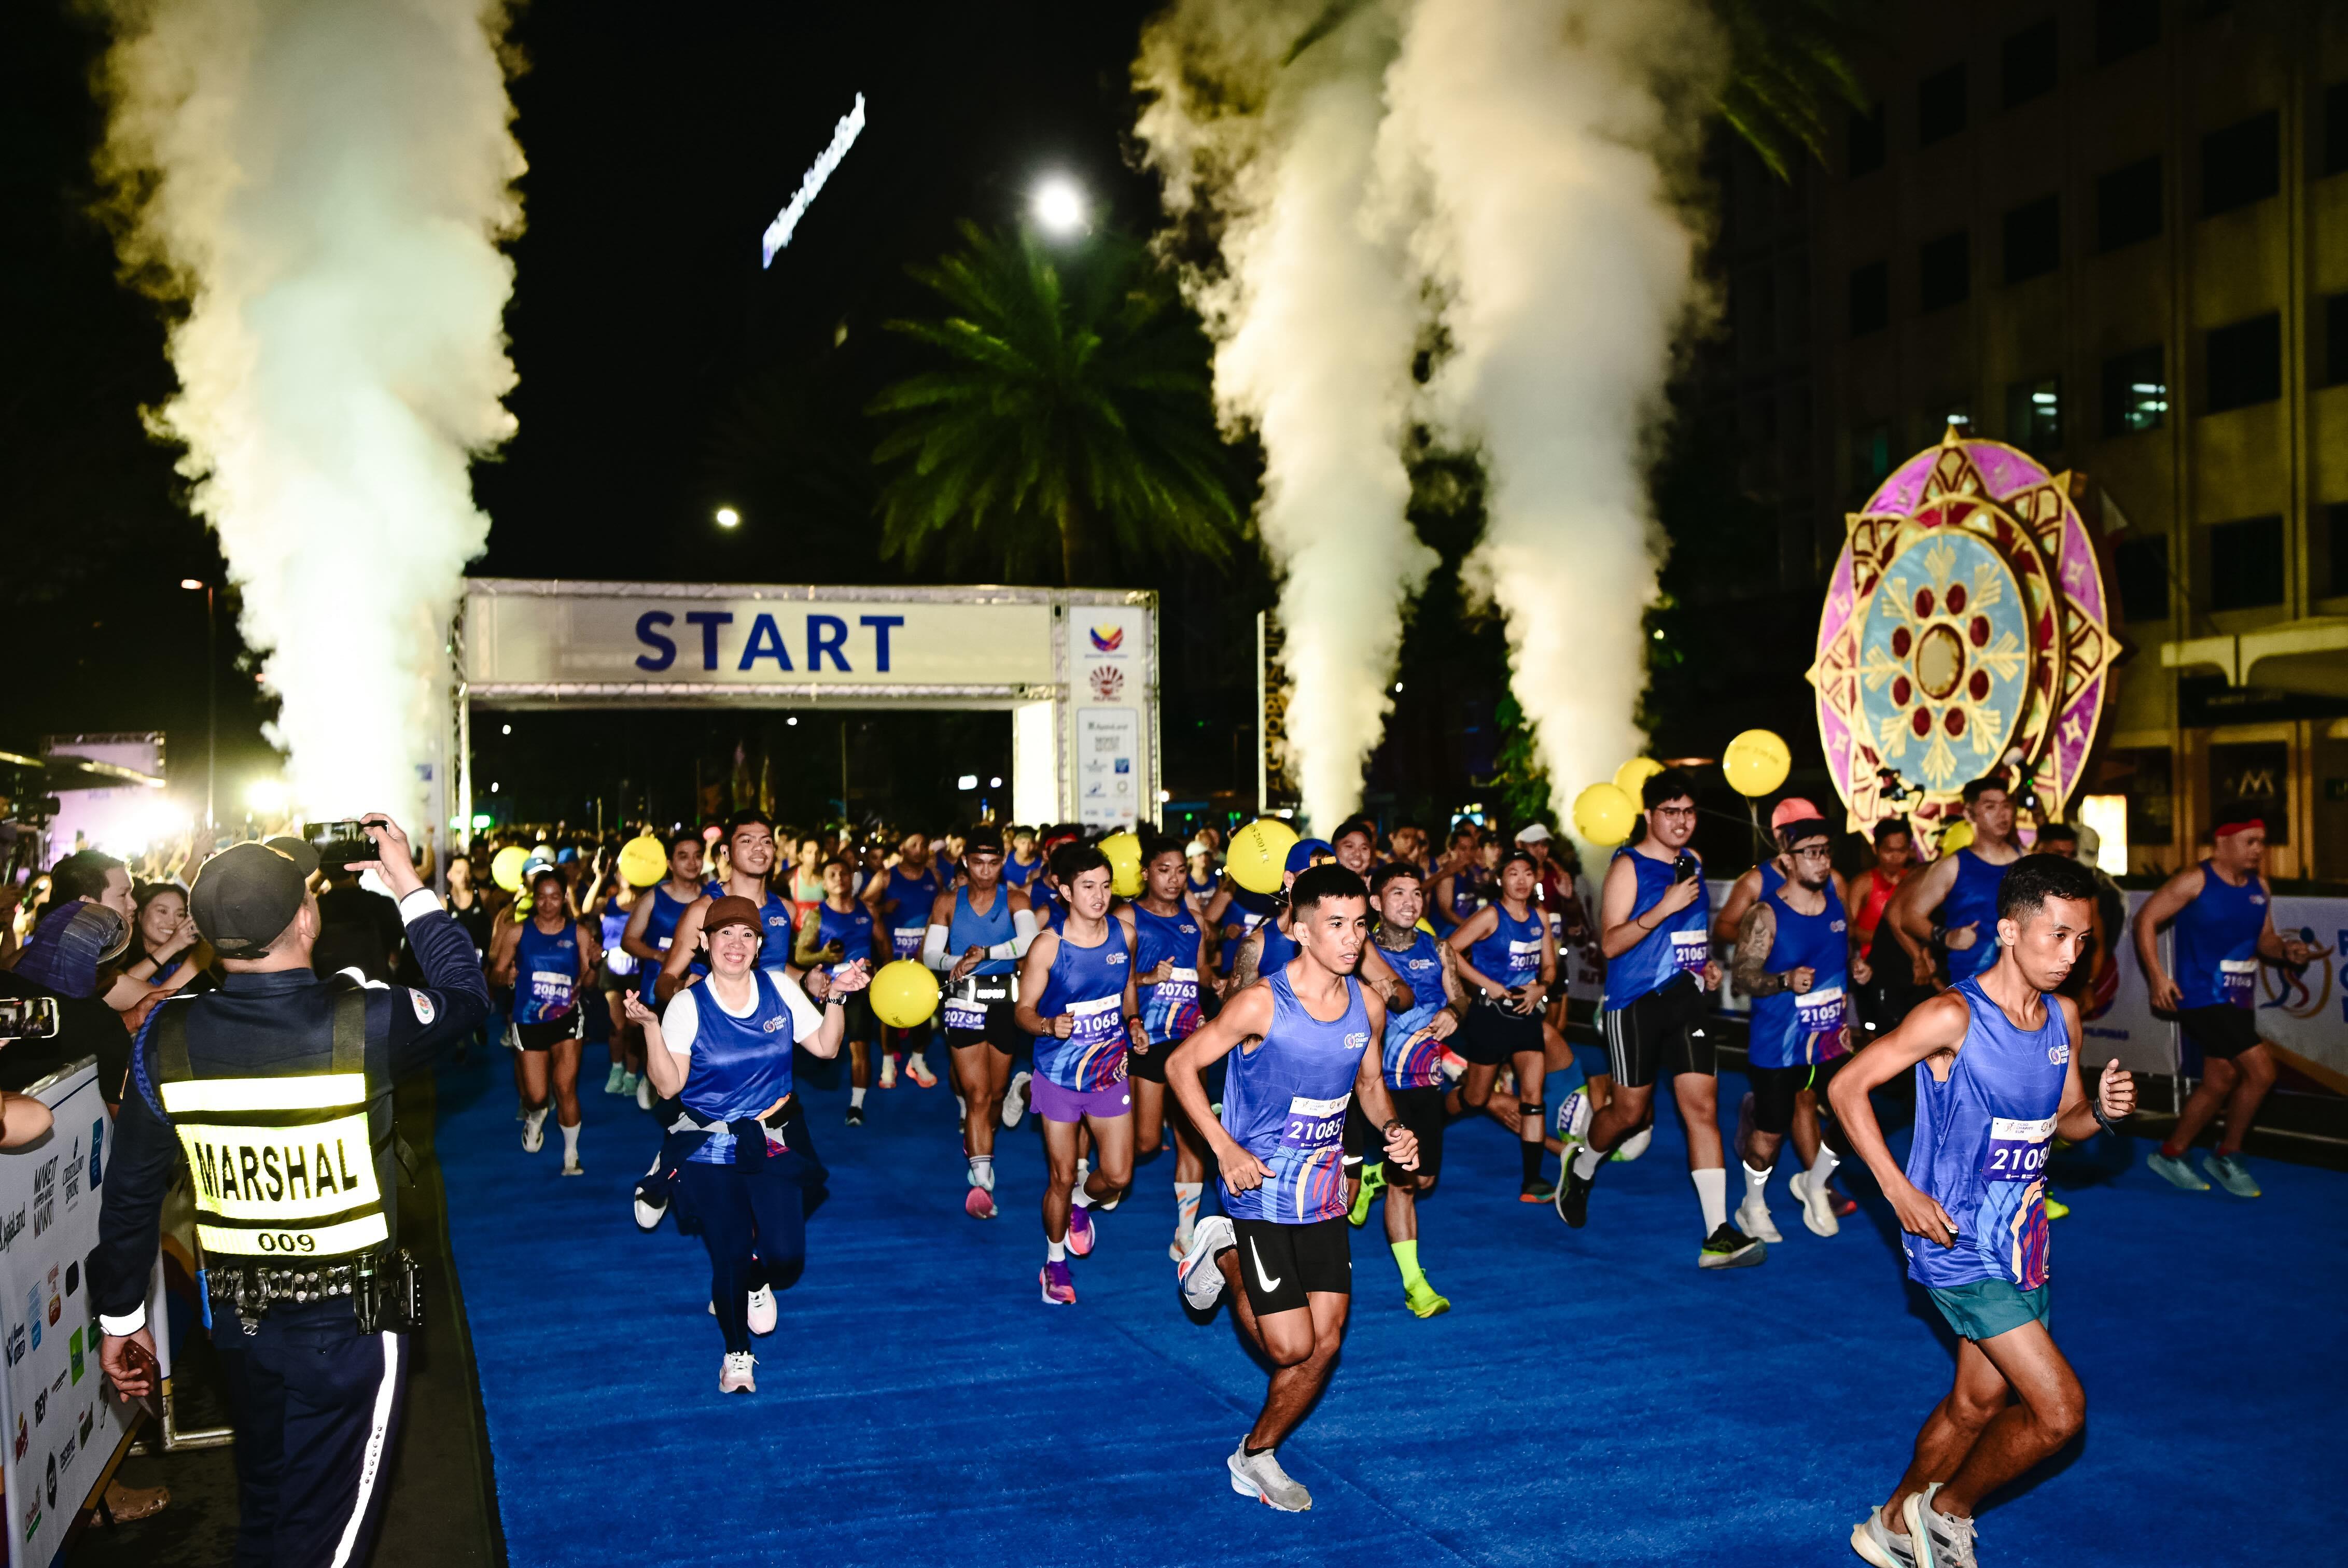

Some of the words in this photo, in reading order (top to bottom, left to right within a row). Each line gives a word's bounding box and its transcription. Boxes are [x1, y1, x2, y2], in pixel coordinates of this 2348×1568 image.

[635, 610, 904, 673] START
[1676, 946, 1707, 962] 21067
[1157, 982, 1196, 998] 20763
[945, 1011, 982, 1024] 20734
[1073, 1012, 1119, 1034] 21068
[1800, 1002, 1841, 1023] 21057
[1288, 1117, 1342, 1140] 21085
[194, 1139, 358, 1202] MARSHAL
[258, 1233, 315, 1252] 009
